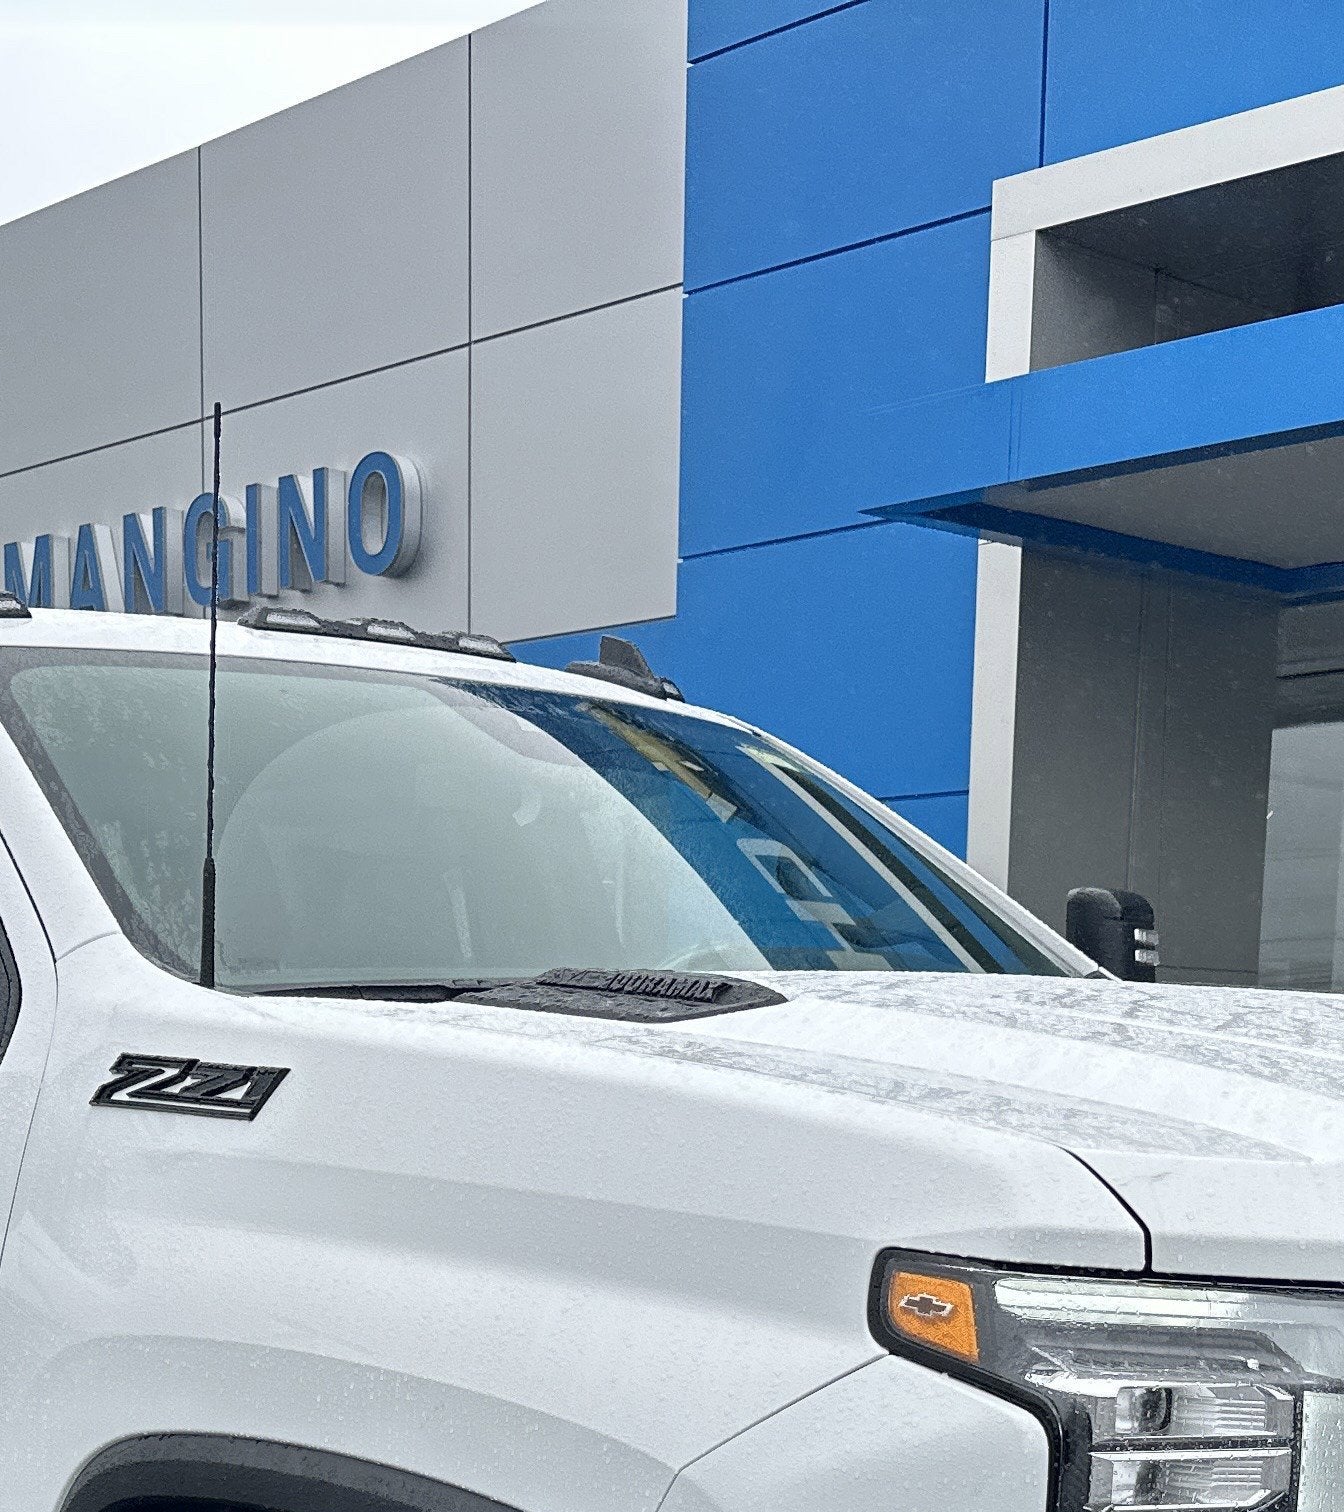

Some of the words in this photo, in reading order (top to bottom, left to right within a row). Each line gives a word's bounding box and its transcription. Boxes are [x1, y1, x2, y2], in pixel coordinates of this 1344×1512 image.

[4, 451, 421, 614] MANGINO
[607, 972, 718, 1003] DURAMAX
[89, 1052, 291, 1121] Z71
